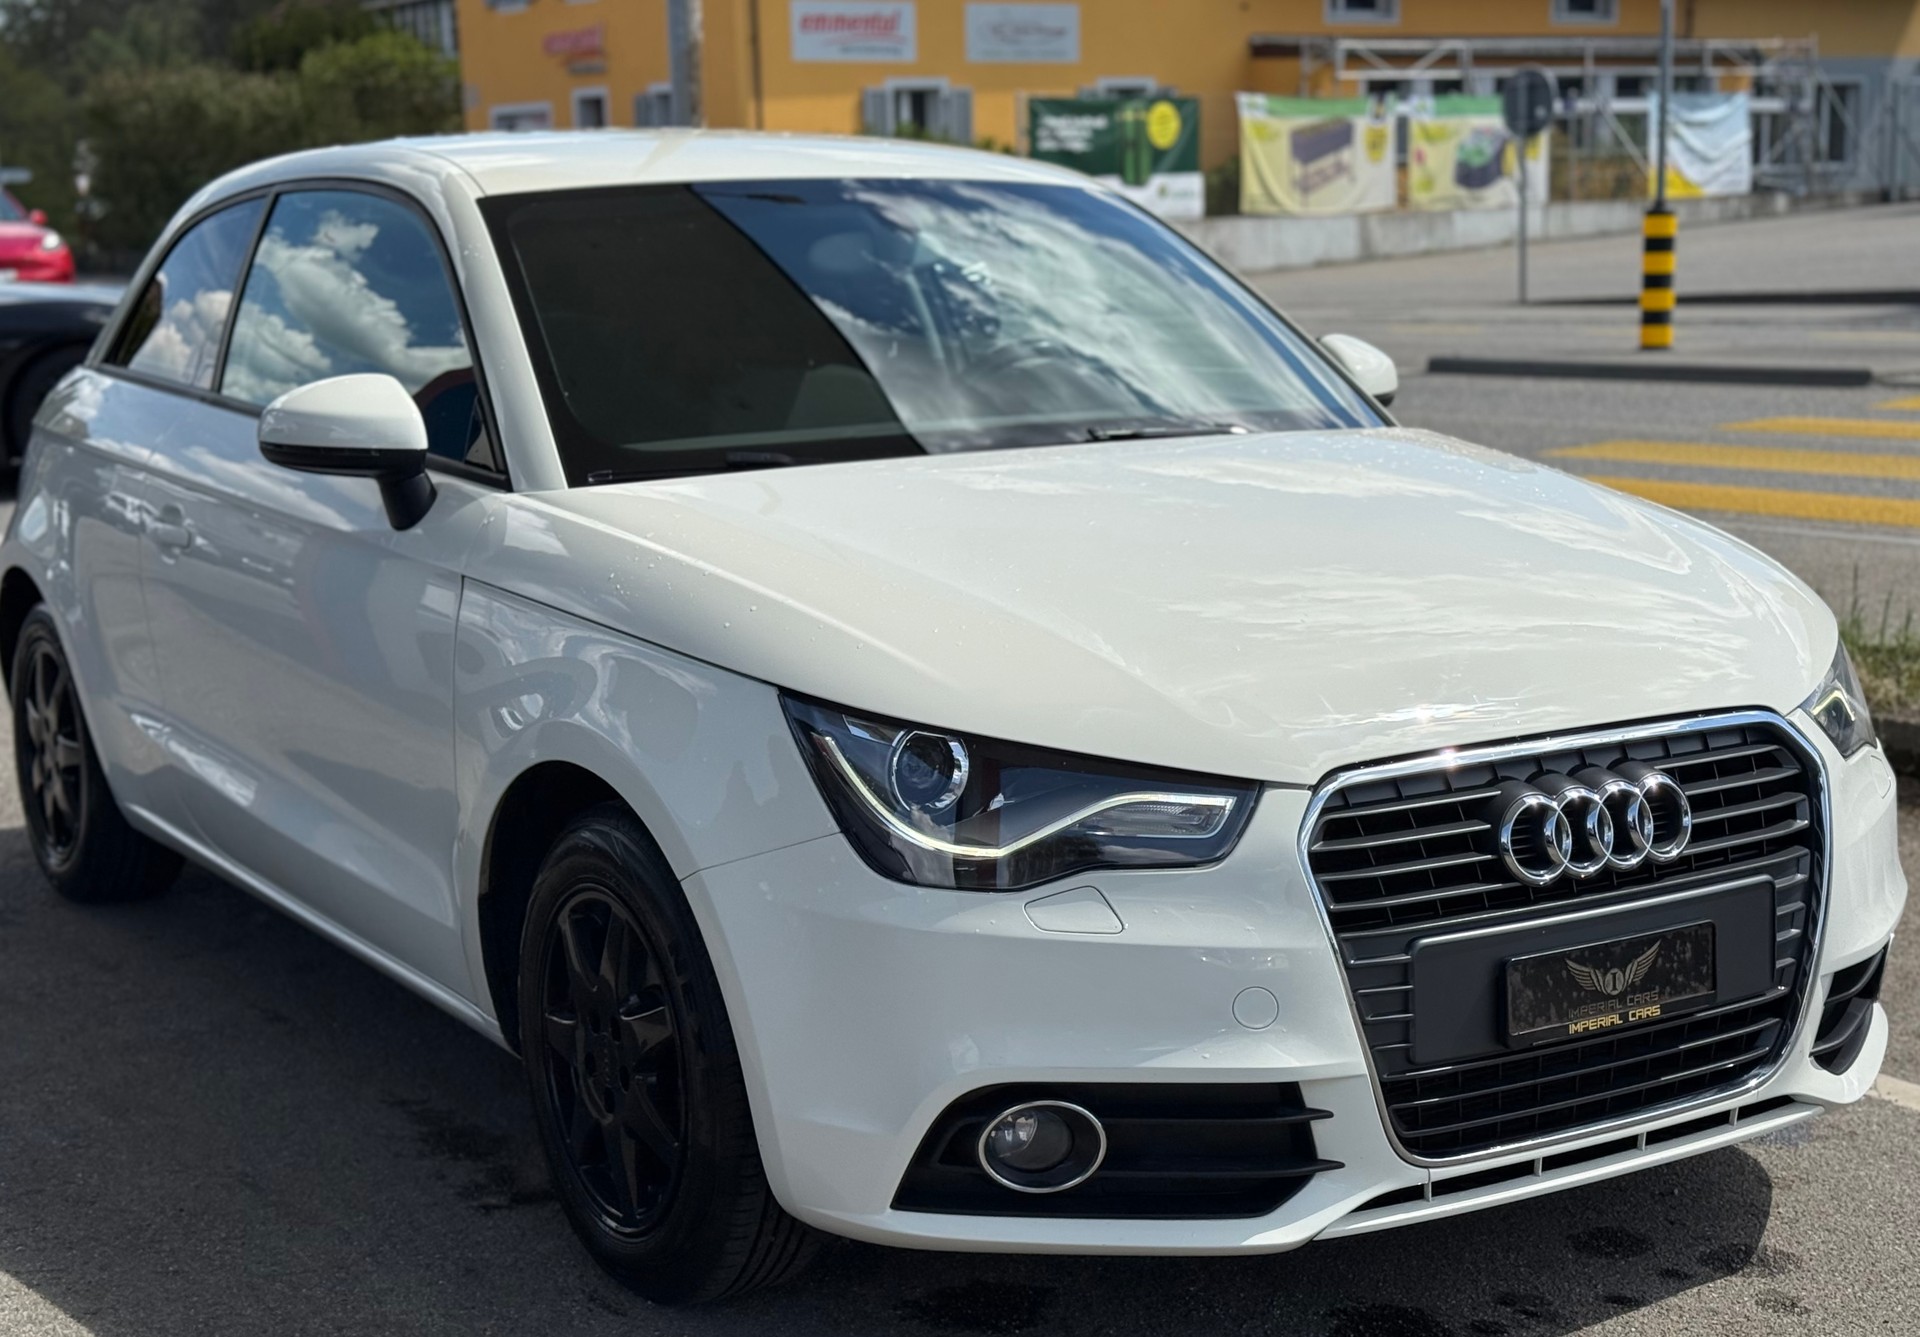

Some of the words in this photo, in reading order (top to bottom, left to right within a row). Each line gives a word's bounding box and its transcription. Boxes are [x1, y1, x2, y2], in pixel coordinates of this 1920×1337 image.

[1568, 999, 1622, 1019] IMPERIAL
[1626, 990, 1659, 1006] CARS
[1568, 1013, 1623, 1035] IMPERIAL
[1628, 1004, 1661, 1021] CARS
